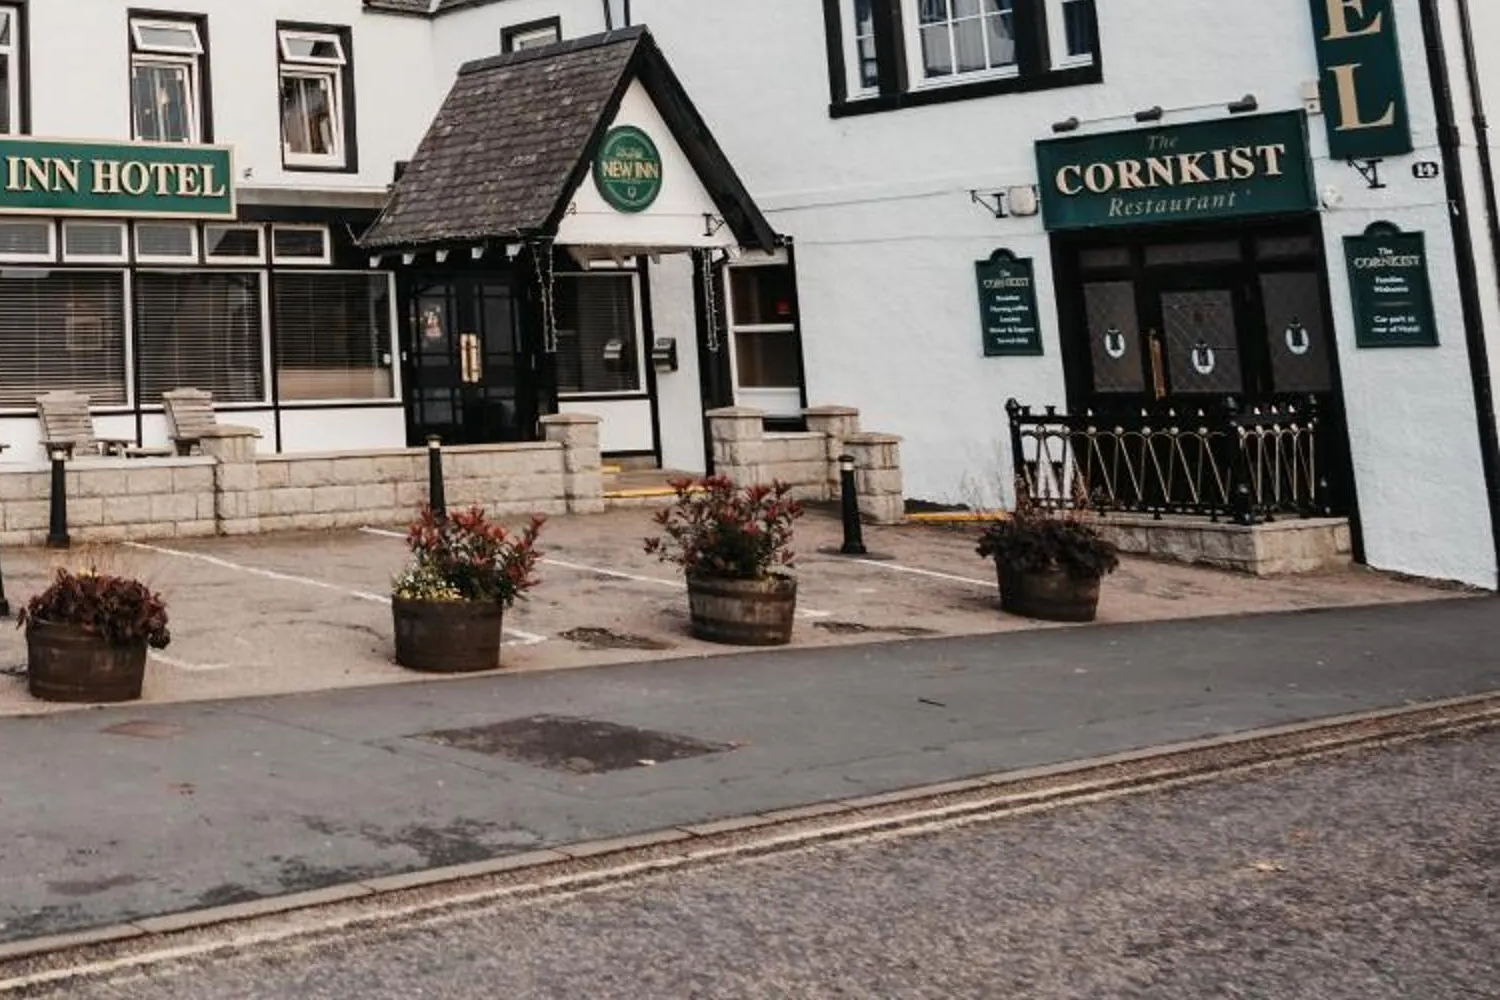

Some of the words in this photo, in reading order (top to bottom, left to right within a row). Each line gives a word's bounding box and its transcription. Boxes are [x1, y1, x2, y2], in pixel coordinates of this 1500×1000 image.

[1147, 134, 1180, 151] The
[5, 155, 82, 194] INN
[91, 158, 226, 198] HOTEL
[601, 160, 633, 177] NEW
[635, 161, 659, 179] INN
[1055, 143, 1285, 196] CORNKIST
[1108, 190, 1237, 218] Restaurant
[1354, 255, 1420, 269] CORNKIST
